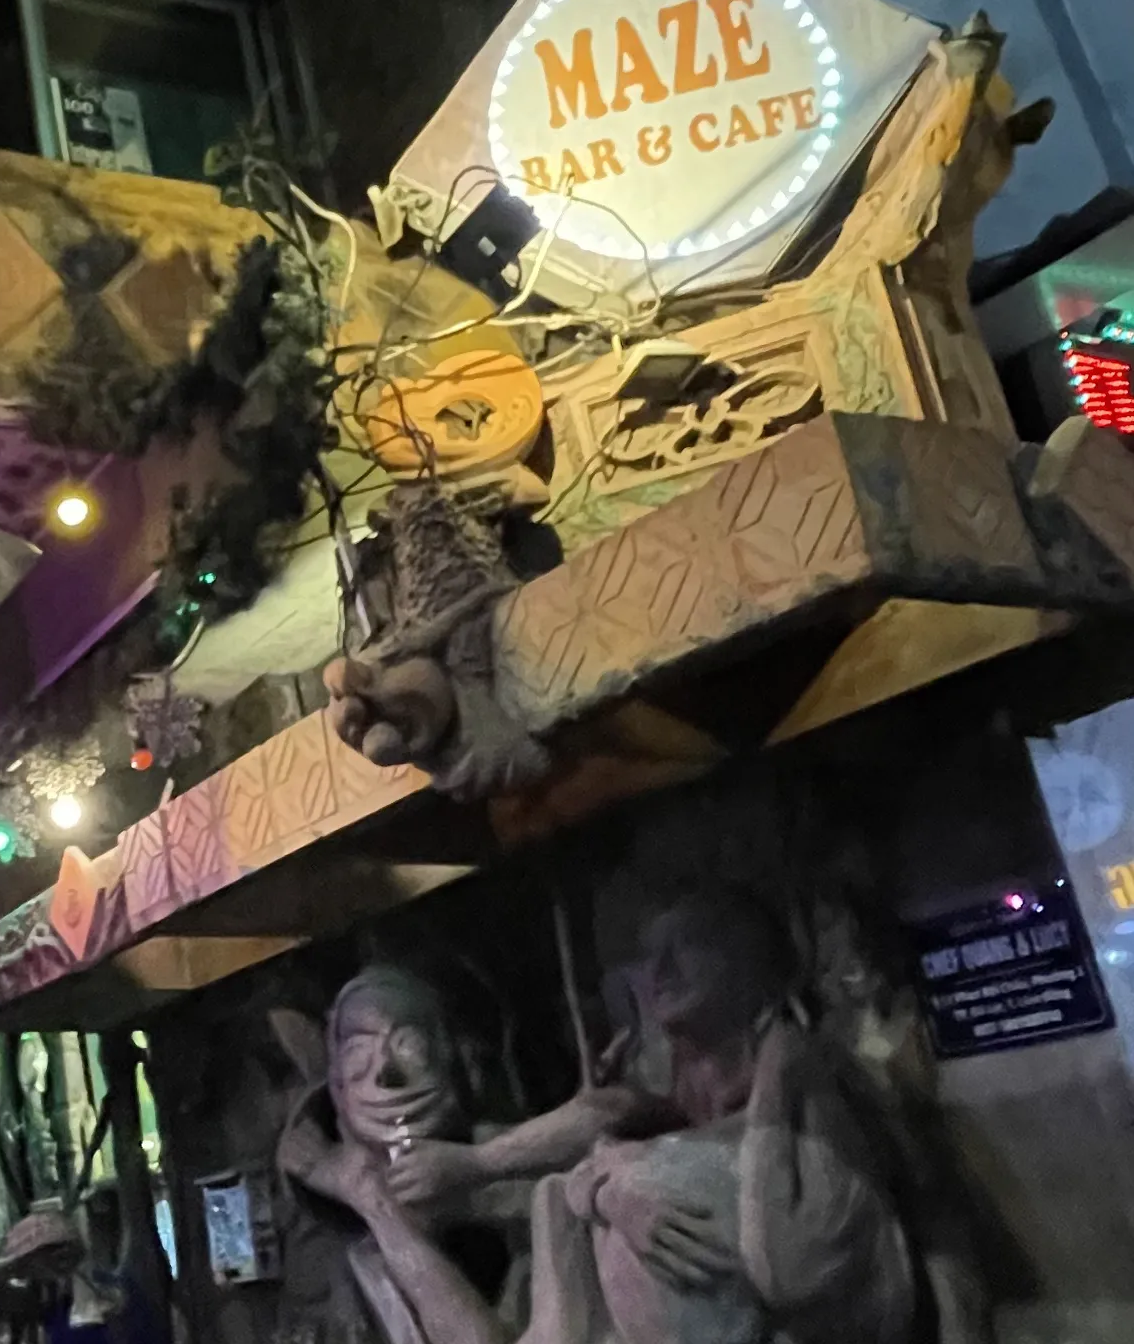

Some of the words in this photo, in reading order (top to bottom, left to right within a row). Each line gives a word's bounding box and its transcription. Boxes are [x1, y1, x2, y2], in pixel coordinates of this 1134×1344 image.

[520, 138, 626, 197] BAR
[636, 124, 673, 167] &
[688, 86, 823, 153] CAFE
